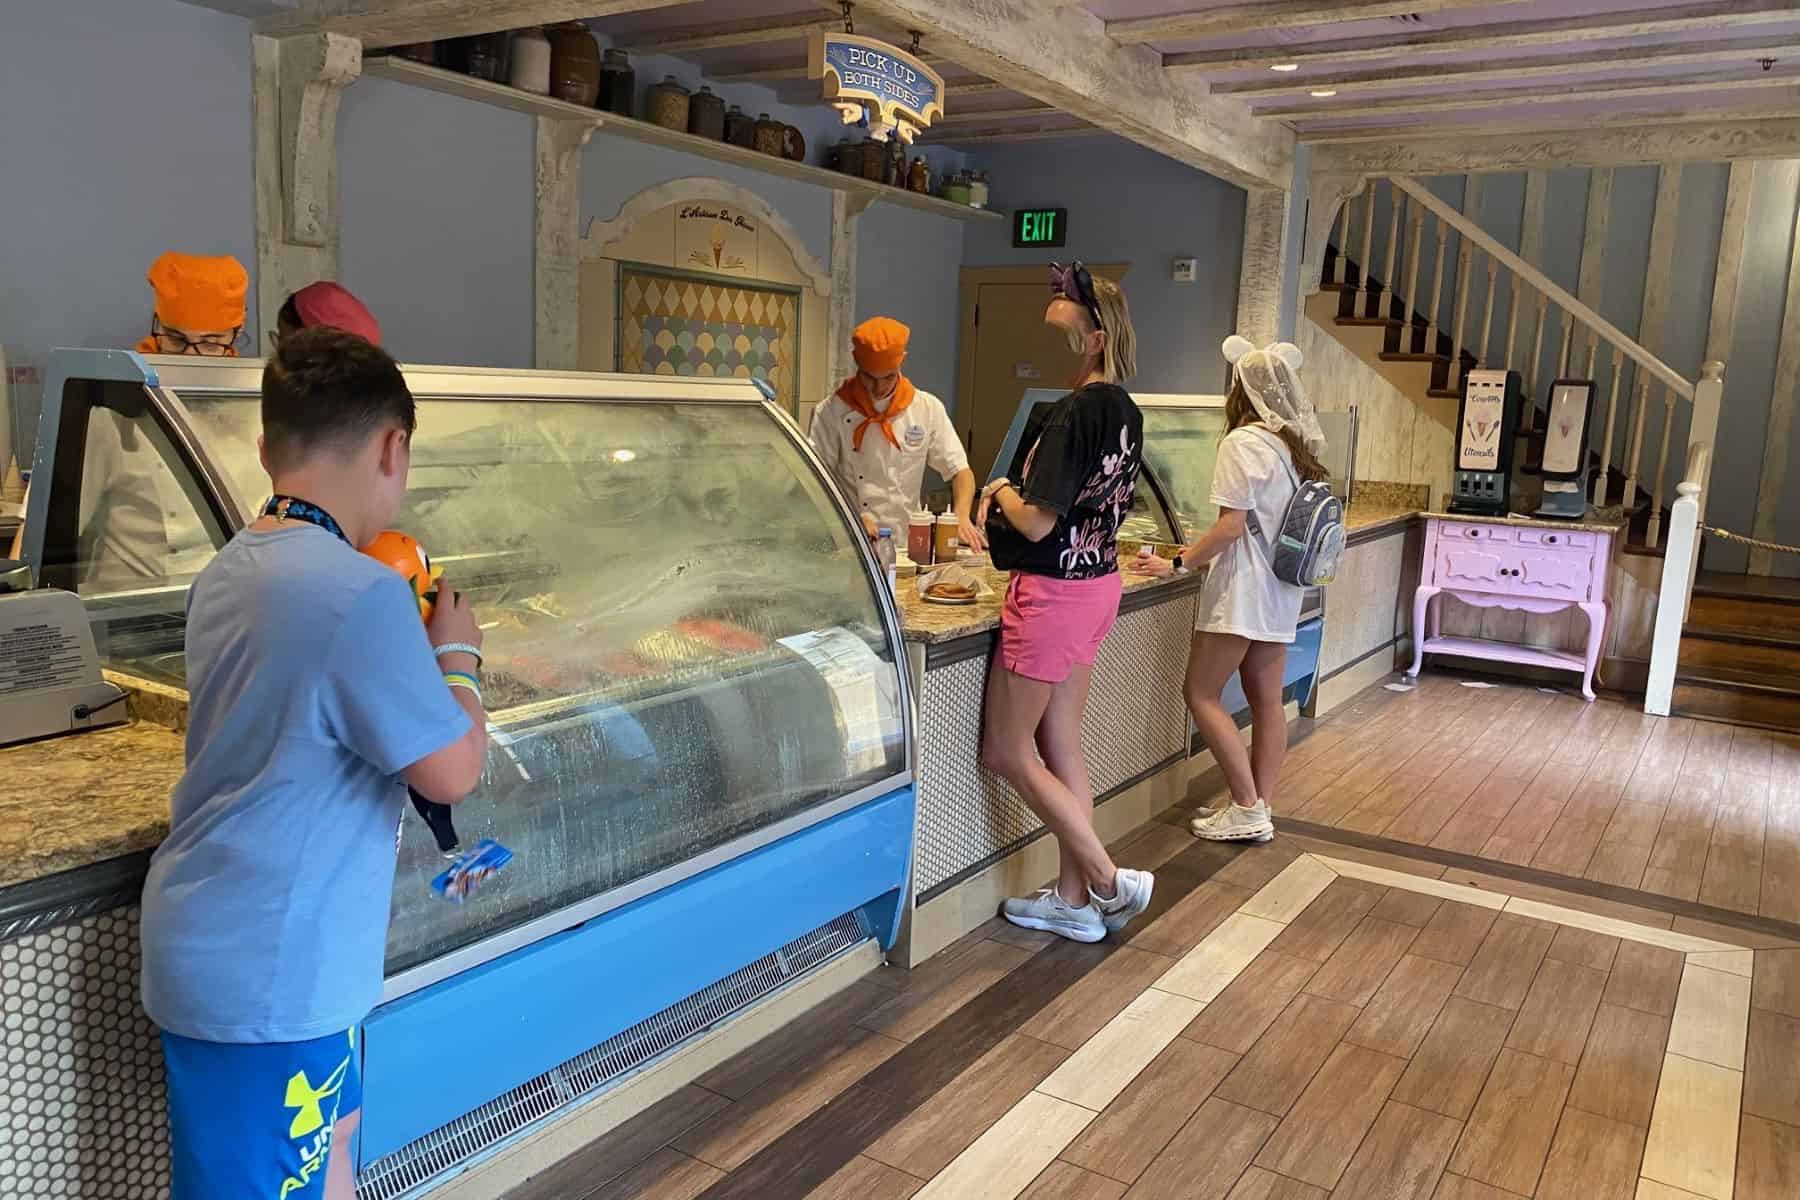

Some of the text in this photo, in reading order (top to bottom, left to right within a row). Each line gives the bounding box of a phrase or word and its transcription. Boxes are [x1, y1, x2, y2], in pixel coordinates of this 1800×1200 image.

[848, 48, 916, 84] PICK UP
[844, 71, 919, 108] BOTH SIDES
[1022, 212, 1056, 241] EXIT
